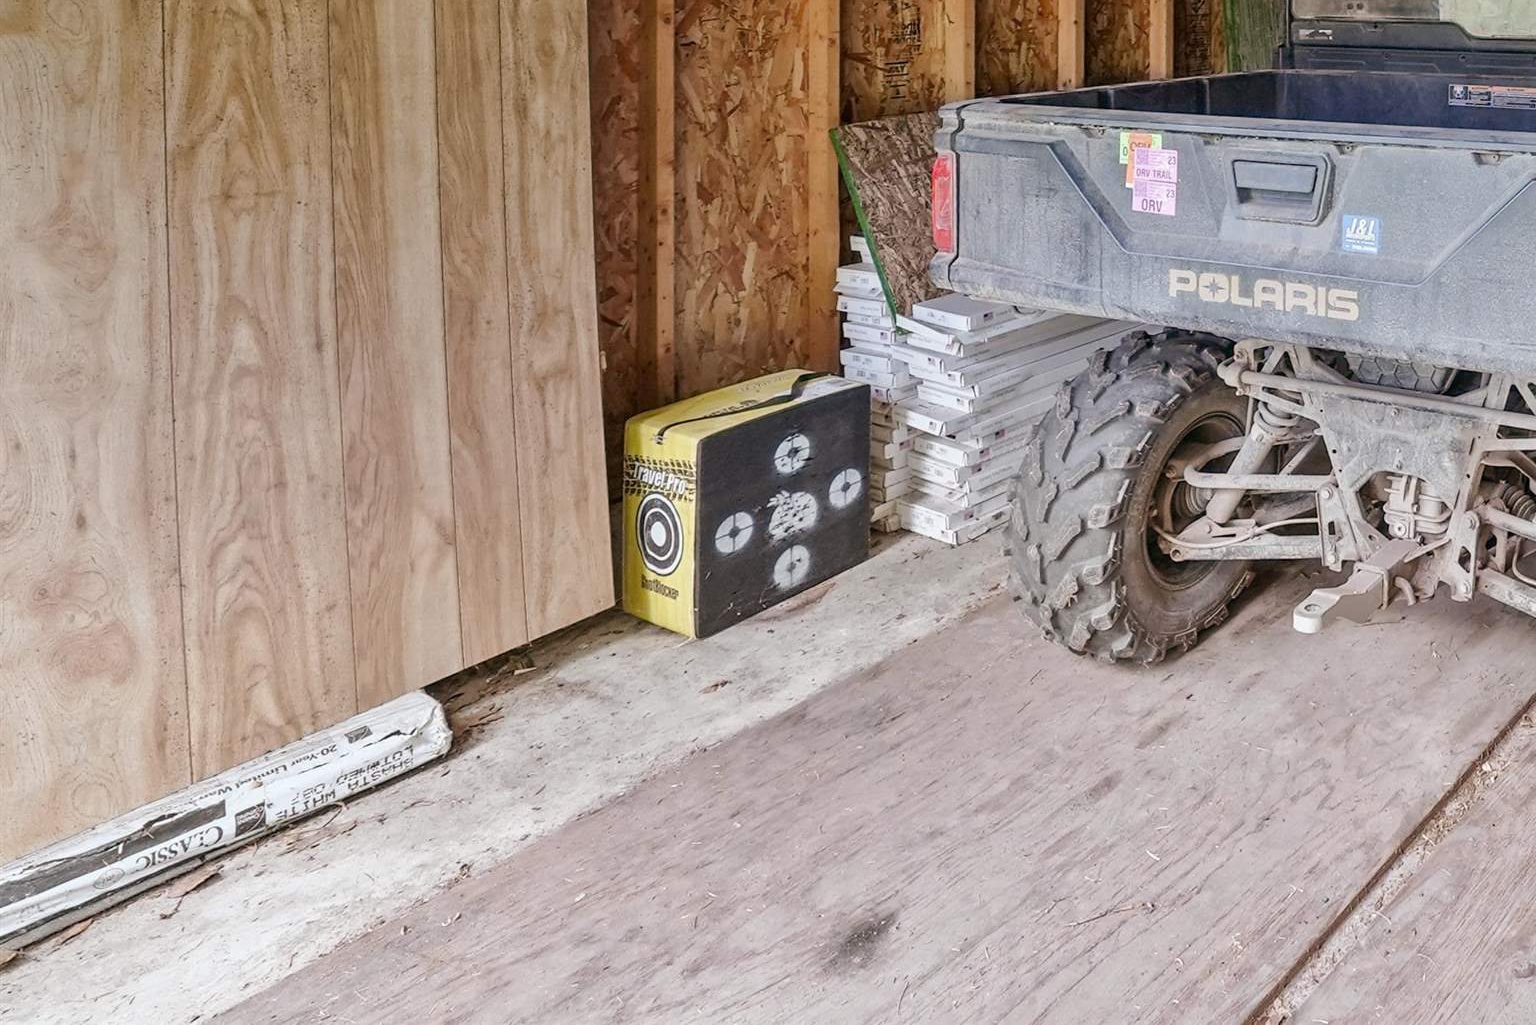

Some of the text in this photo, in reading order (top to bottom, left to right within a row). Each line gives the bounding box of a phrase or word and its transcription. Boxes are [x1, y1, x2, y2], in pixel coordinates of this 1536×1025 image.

[1167, 156, 1176, 165] 23
[1141, 198, 1163, 212] ORV
[1166, 189, 1176, 198] 23
[1168, 268, 1360, 322] POLARIS
[633, 461, 688, 496] Travel Pro
[348, 757, 414, 791] SHASTA
[135, 825, 224, 872] CLASSIC
